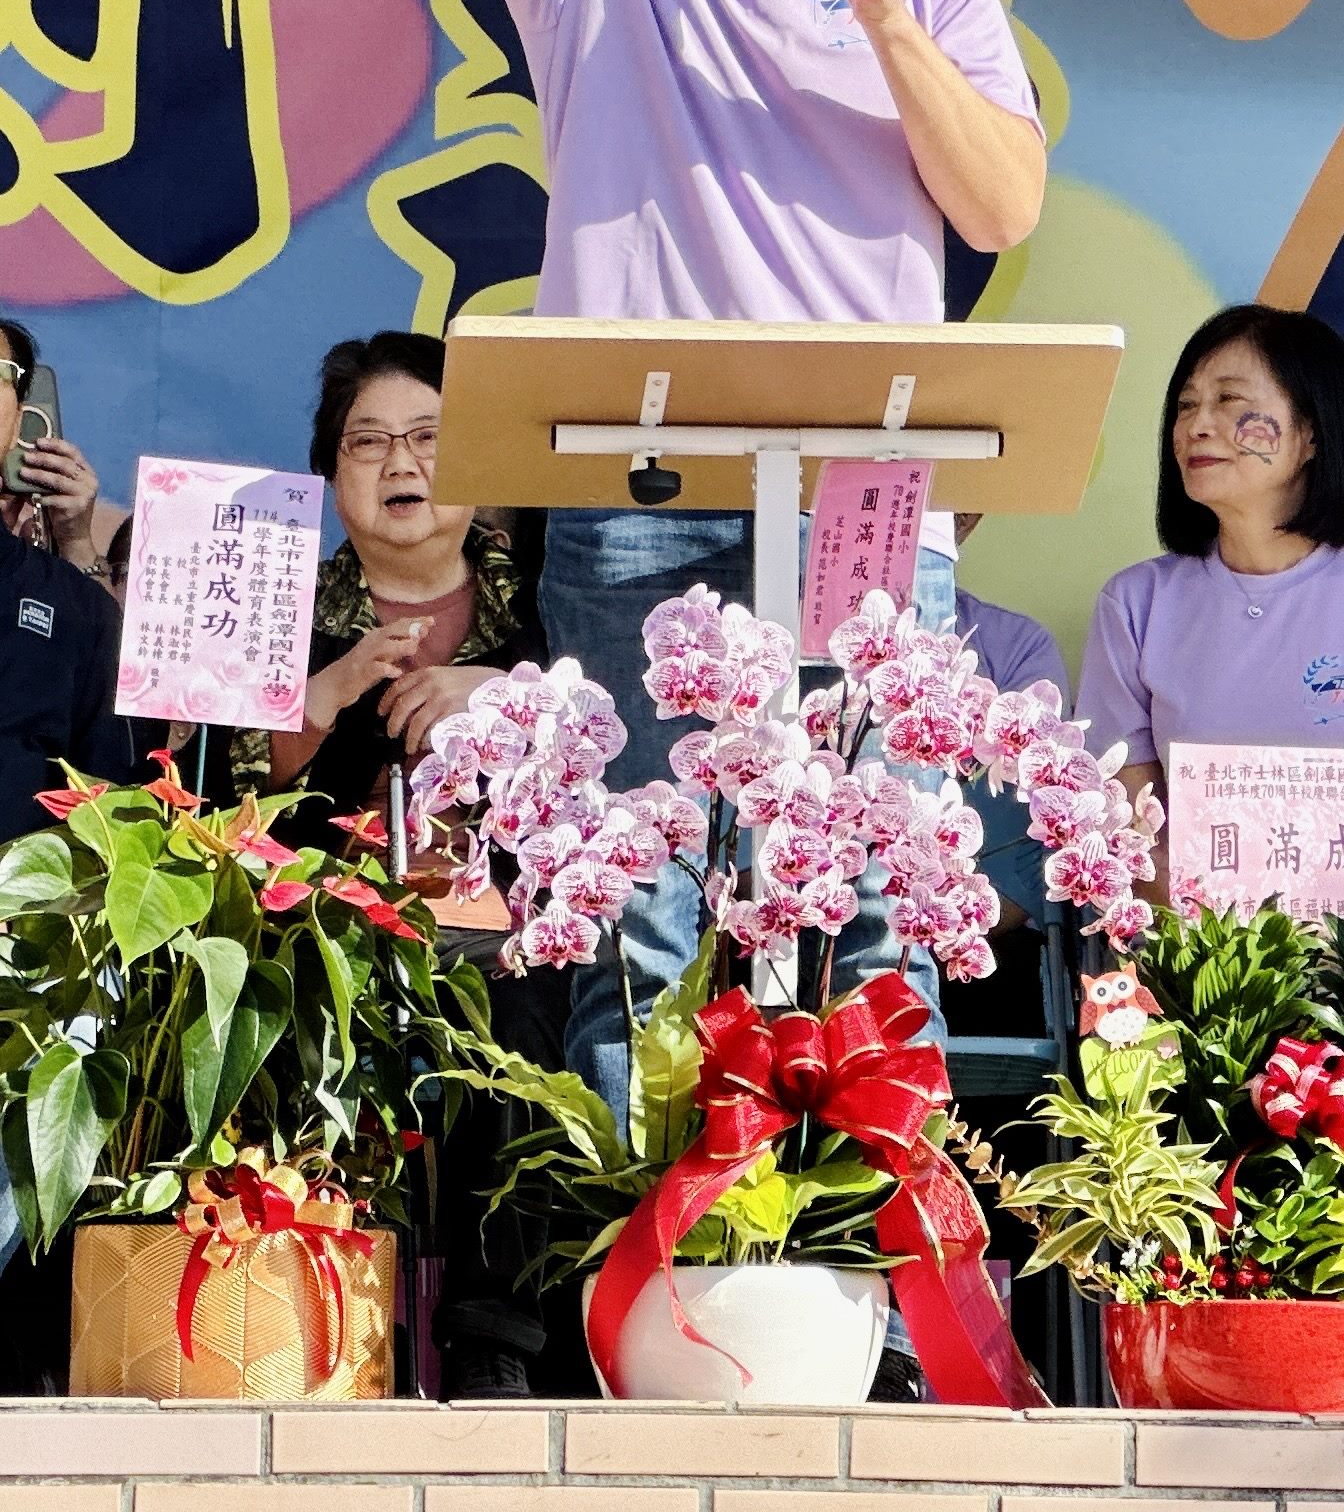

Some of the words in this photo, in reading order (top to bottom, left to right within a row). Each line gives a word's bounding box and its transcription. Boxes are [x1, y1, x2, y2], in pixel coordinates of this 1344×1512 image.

[283, 488, 309, 504] 賀
[847, 487, 880, 614] 圓滿成功
[880, 484, 905, 591] 70週年校慶聯合社區
[201, 503, 246, 639] 圓滿成功
[262, 518, 306, 697] 臺北市士林區劍潭國民小學
[1178, 763, 1196, 780] 祝
